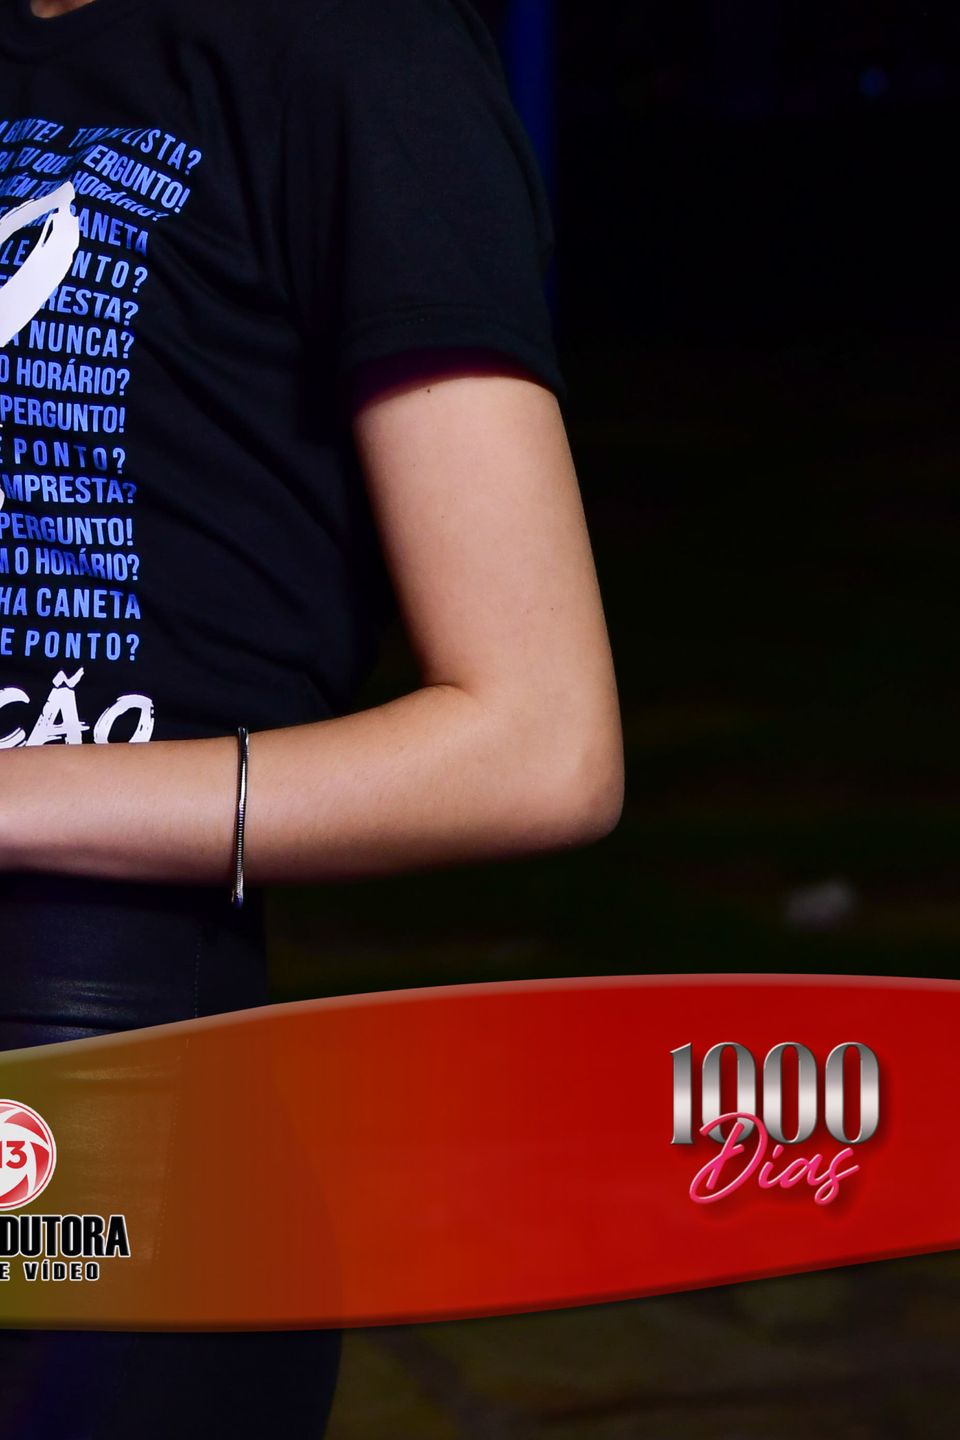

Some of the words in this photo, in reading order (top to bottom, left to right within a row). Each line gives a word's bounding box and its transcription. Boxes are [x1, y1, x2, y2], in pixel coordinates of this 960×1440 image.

[70, 202, 149, 258] ANETA
[71, 250, 148, 294] NTO?
[28, 319, 135, 359] NUNCA?
[16, 358, 131, 396] HORÁRIO?
[0, 394, 126, 433] PERGUNTO!
[13, 437, 126, 474] PONTO?
[14, 546, 29, 575] O
[35, 546, 140, 582] HORÁRIO?
[36, 587, 141, 620] CANETA
[24, 629, 140, 661] PONTO?
